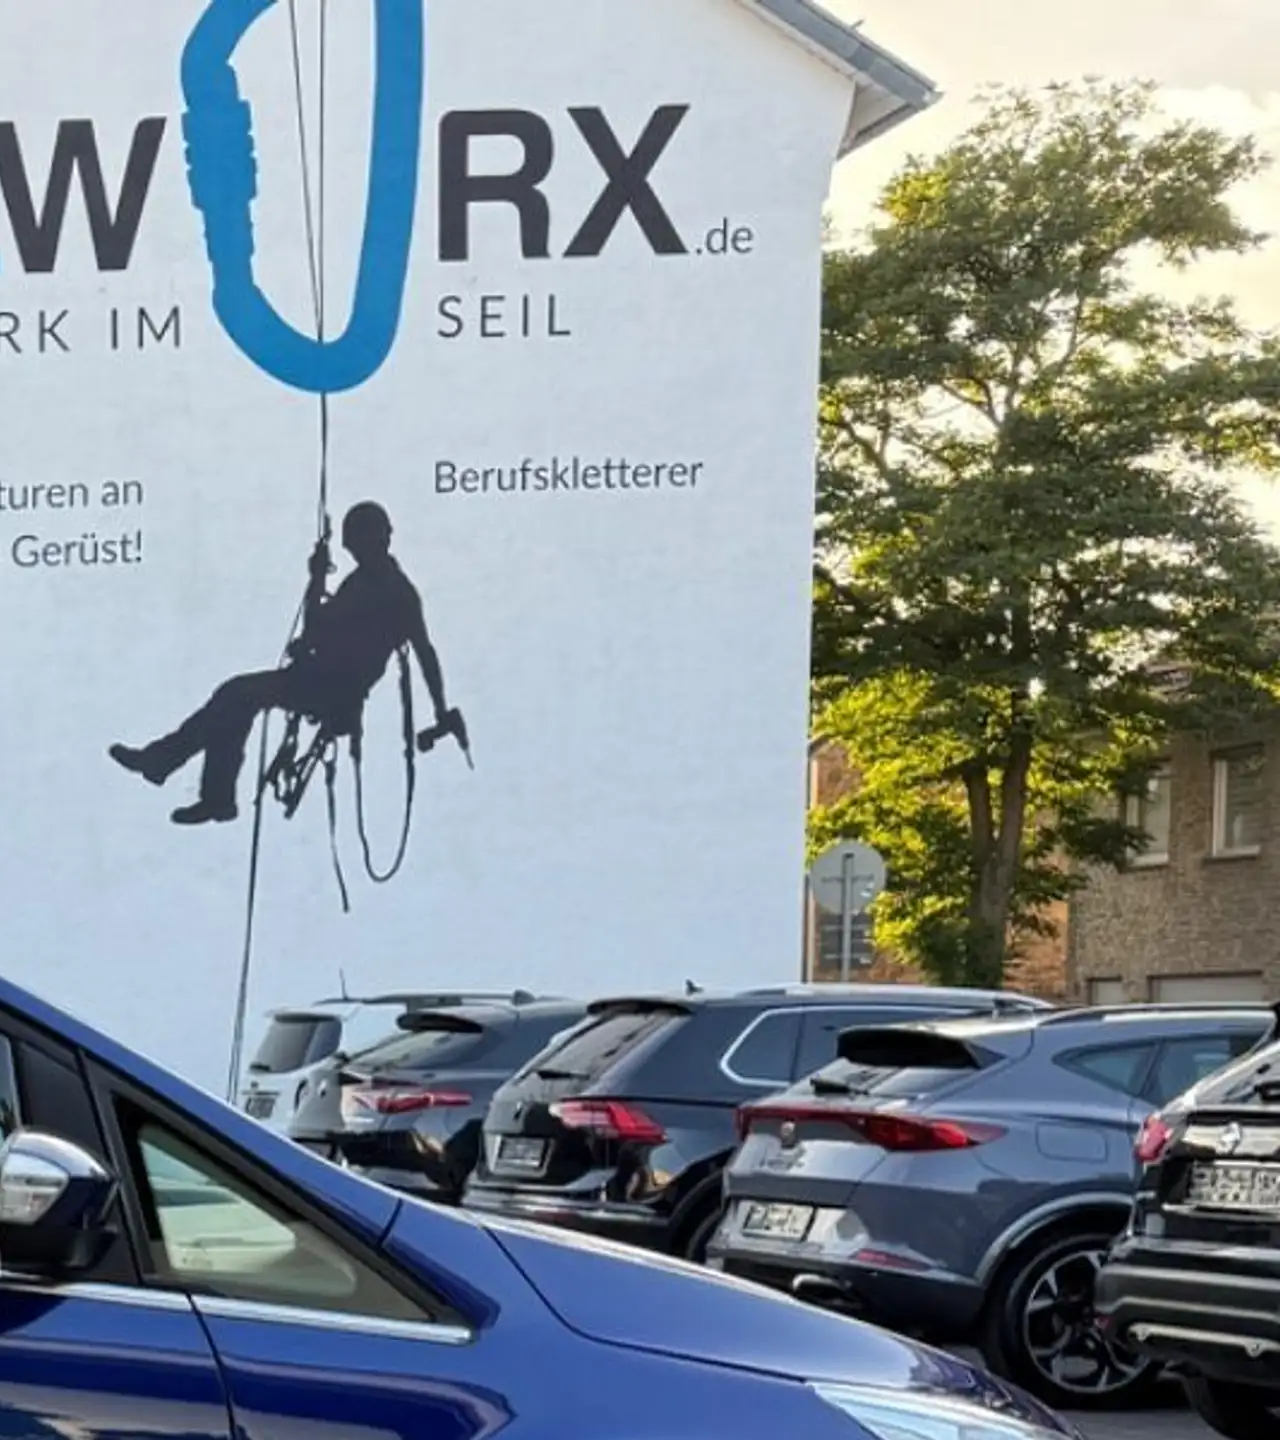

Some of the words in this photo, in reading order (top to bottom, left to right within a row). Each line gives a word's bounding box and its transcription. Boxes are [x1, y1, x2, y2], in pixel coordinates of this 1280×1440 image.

[109, 303, 182, 353] IM
[435, 292, 573, 340] SEIL
[99, 480, 145, 509] an
[433, 455, 705, 495] Berufskletterer
[10, 527, 143, 570] Gerüst!
